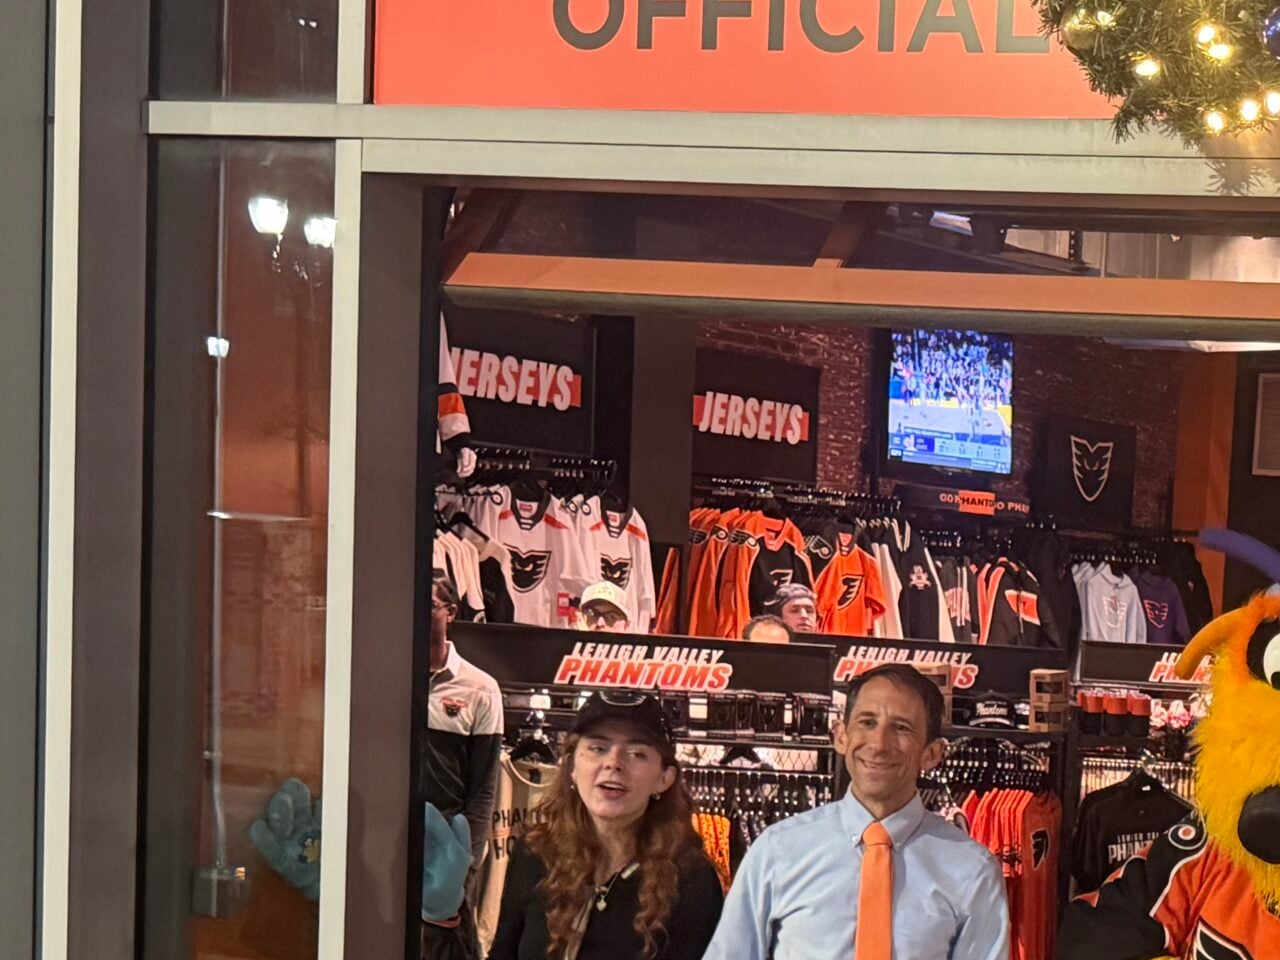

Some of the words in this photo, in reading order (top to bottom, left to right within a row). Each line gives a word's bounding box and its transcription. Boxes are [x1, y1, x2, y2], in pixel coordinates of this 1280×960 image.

[698, 391, 804, 445] JERSEYS
[571, 642, 648, 661] LEHIGH
[652, 646, 724, 664] VALLEY
[848, 646, 911, 663] LEHIGH
[911, 649, 972, 665] VALLEY
[553, 655, 733, 692] PHANTOMS
